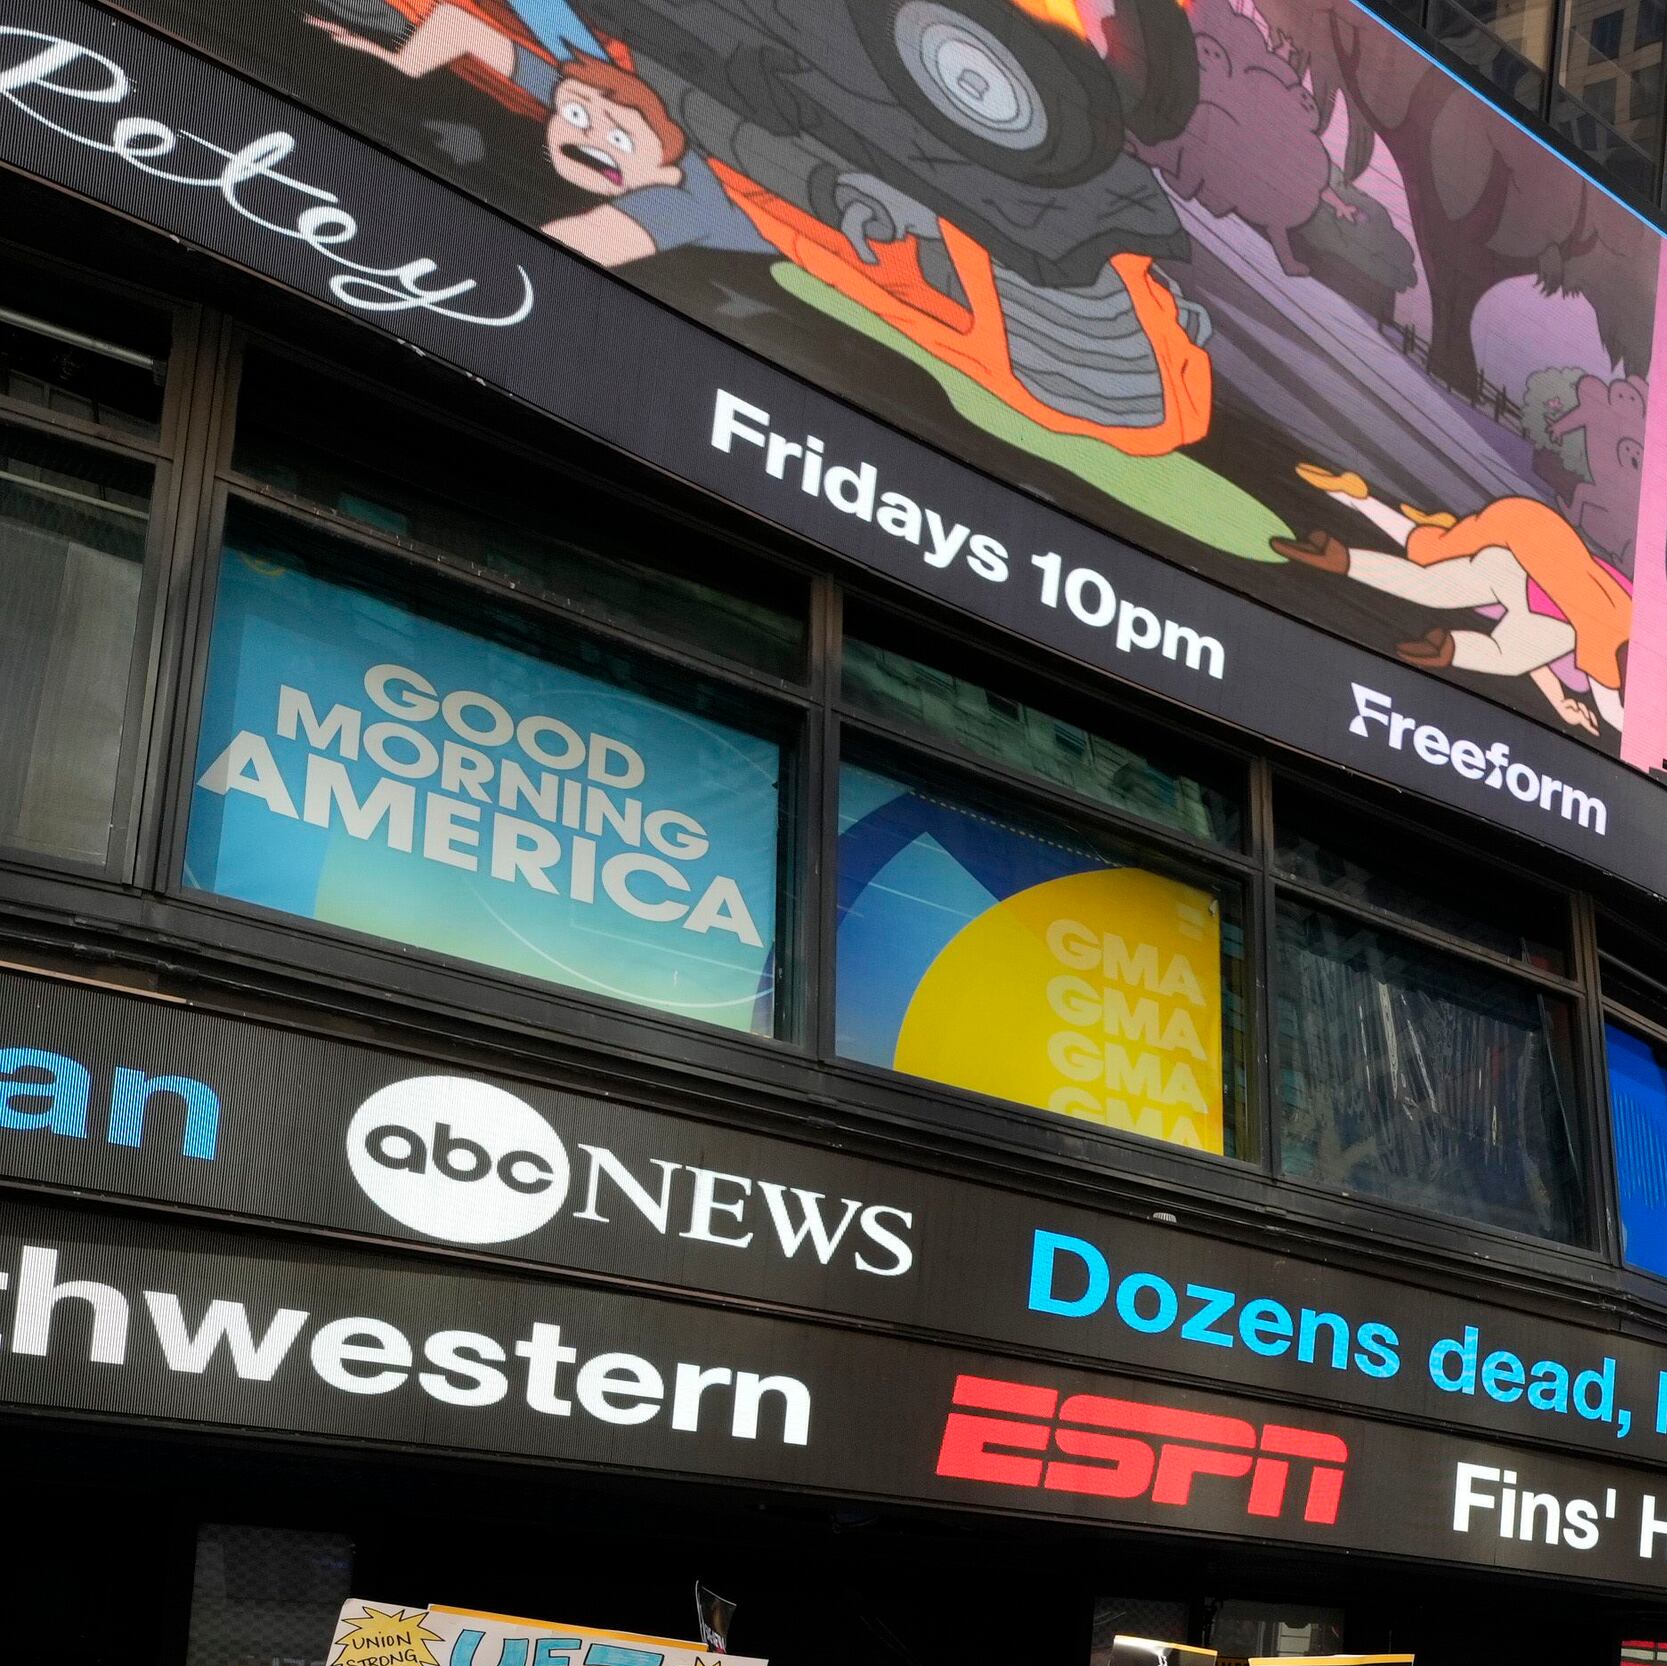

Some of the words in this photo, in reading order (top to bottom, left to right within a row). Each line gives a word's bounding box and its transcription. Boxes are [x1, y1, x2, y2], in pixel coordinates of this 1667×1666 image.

[712, 389, 1008, 583] Fridays
[1033, 552, 1224, 680] 10pm
[277, 684, 711, 862] MORNING
[364, 662, 646, 791] GOOD
[1349, 681, 1607, 835] Freeform
[198, 731, 764, 948] AMERICA
[1046, 919, 1206, 1007] GMA
[1046, 975, 1207, 1061] GMA
[1047, 1031, 1208, 1114] GMA
[364, 1122, 556, 1196] abc
[573, 1143, 913, 1278] NEWS
[1027, 1229, 1400, 1379] Dozens
[1430, 1326, 1631, 1440] dead,
[936, 1375, 1347, 1526] ESPN
[1452, 1461, 1616, 1552] Fins'
